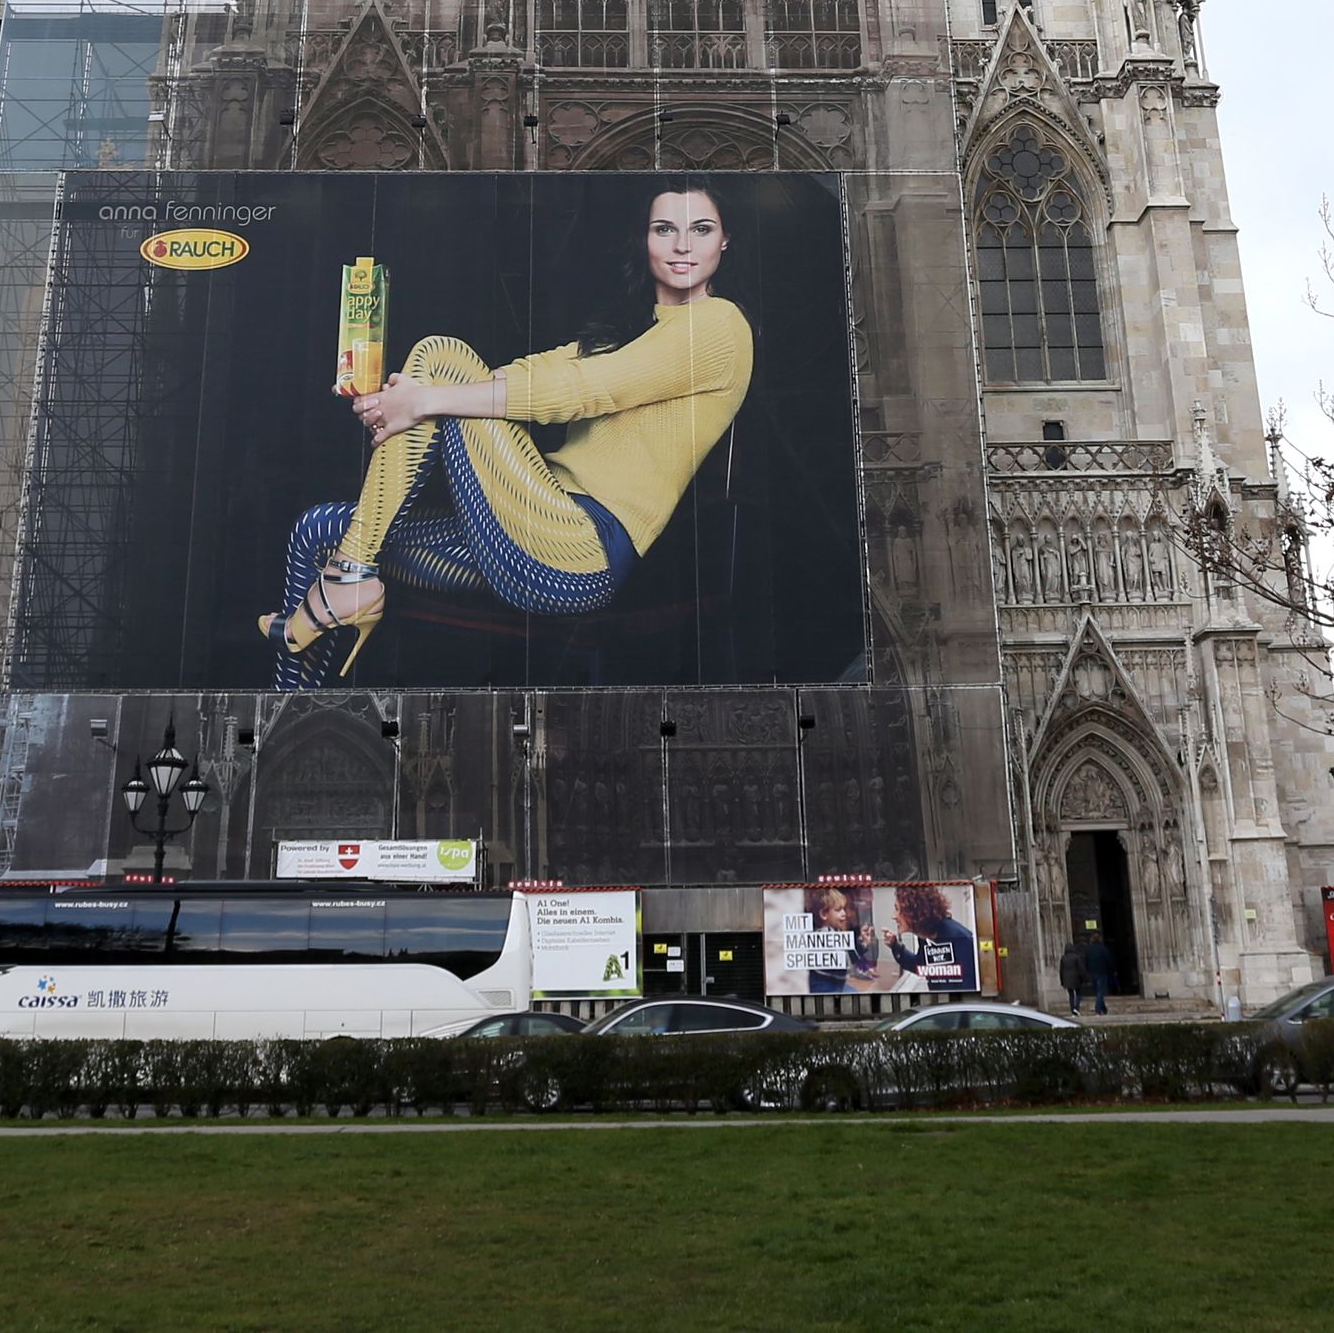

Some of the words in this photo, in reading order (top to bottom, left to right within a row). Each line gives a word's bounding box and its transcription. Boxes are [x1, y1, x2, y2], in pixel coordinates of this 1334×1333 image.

[98, 205, 157, 221] anna
[165, 200, 277, 227] fenninger
[169, 240, 235, 258] RAUCH
[347, 306, 373, 323] day
[280, 844, 318, 852] Powered
[320, 844, 330, 853] by
[550, 899, 570, 907] One!
[537, 908, 558, 916] Alles
[560, 908, 568, 916] in
[570, 908, 597, 916] einem.
[537, 917, 551, 925] Die
[552, 917, 578, 925] neuen
[593, 916, 624, 924] Kombis.
[785, 915, 809, 929] MIT
[786, 953, 843, 969] SPIELEN.
[916, 964, 963, 977] woman
[17, 995, 79, 1009] caissa
